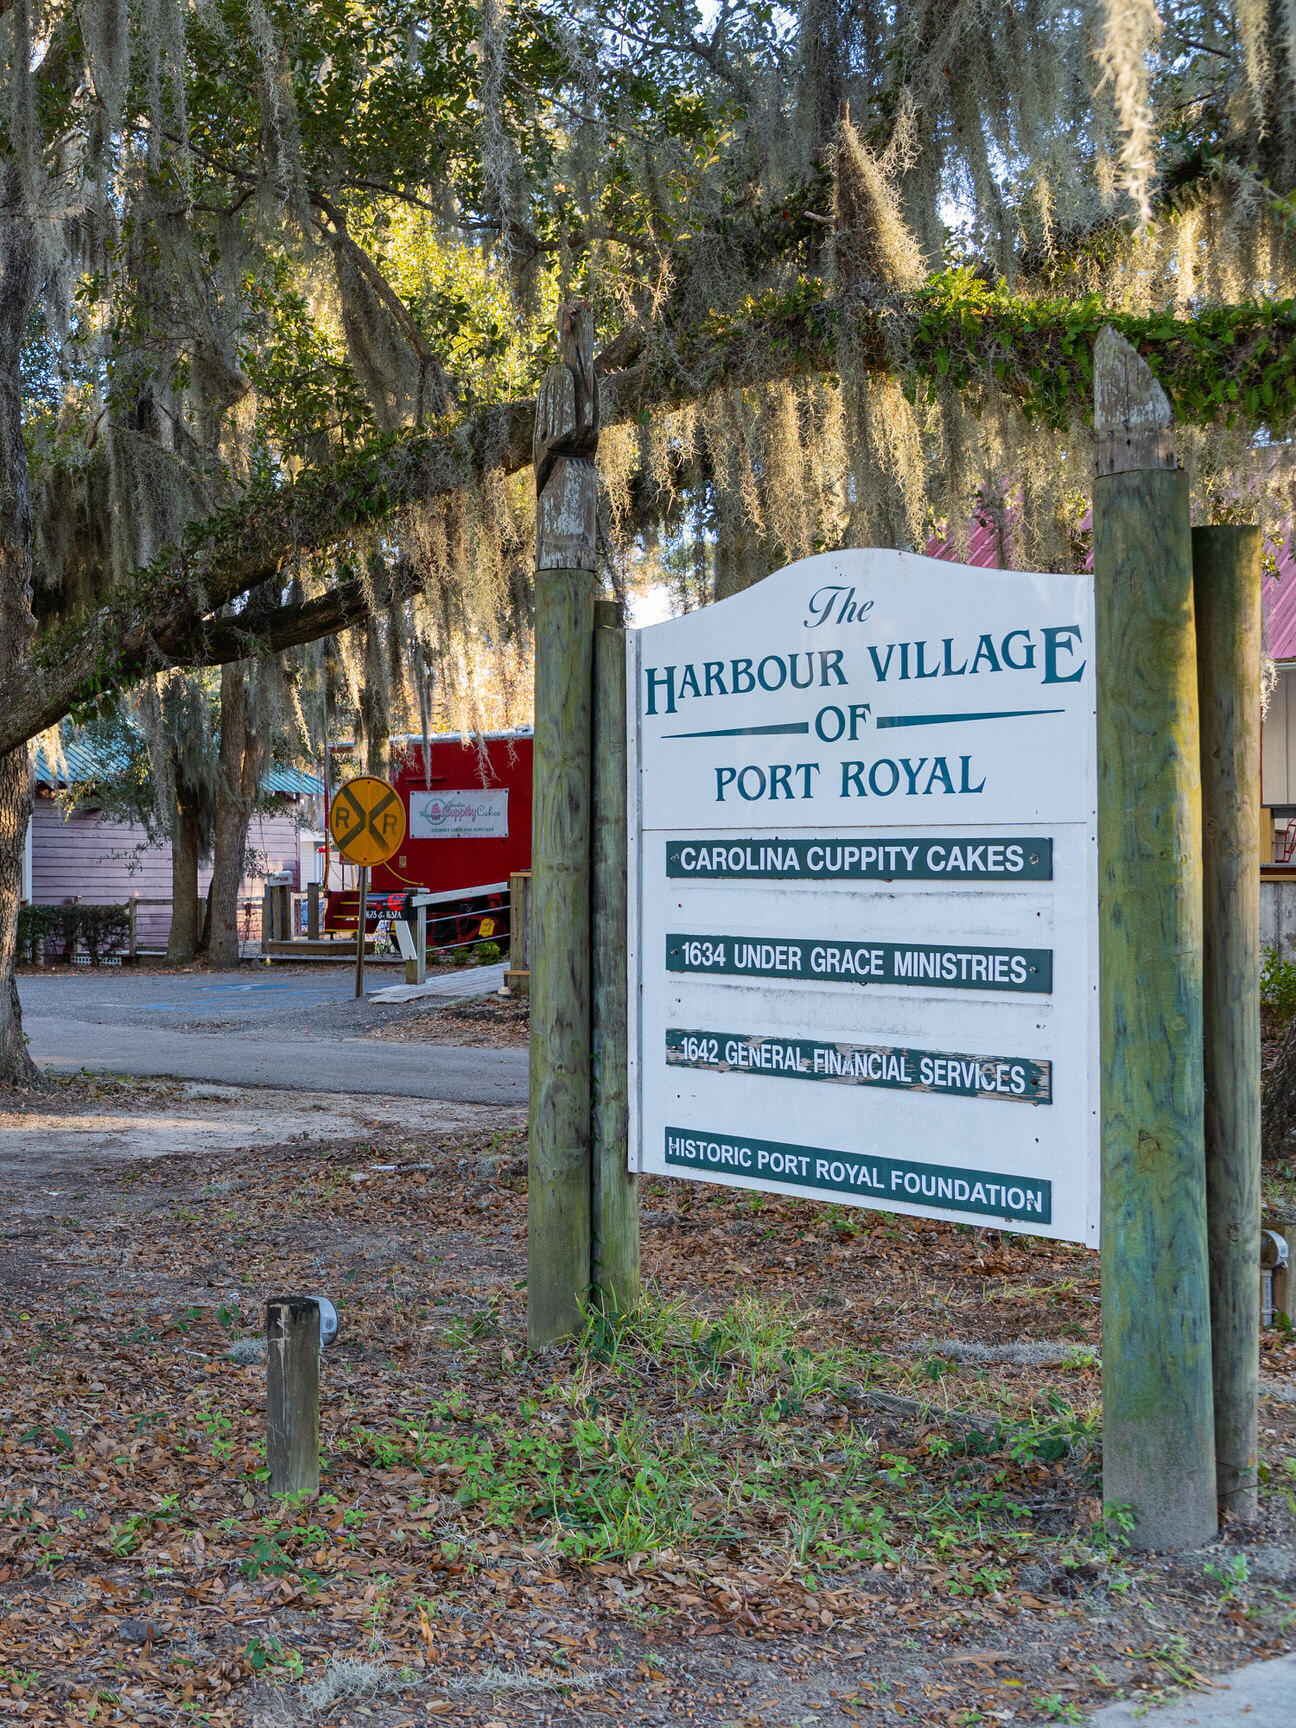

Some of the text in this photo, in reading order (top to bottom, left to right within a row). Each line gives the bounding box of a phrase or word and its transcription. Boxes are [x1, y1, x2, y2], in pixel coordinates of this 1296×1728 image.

[804, 585, 874, 629] The
[644, 624, 1087, 716] HARBOUR VILLAGE
[814, 702, 872, 743] OF
[714, 755, 987, 802] PORT ROYAL
[335, 806, 398, 835] R R
[477, 804, 501, 817] Cakes
[680, 844, 1025, 873] CAROLINA CUPPITY CAKES
[681, 941, 1027, 984] 1634 UNDER GRACE MINISTRIES
[680, 1037, 1026, 1094] 1642 GENERAL FINANCIAL SERVICES
[668, 1136, 1043, 1213] HISTORIC PORT ROYAL FOUNDATION
